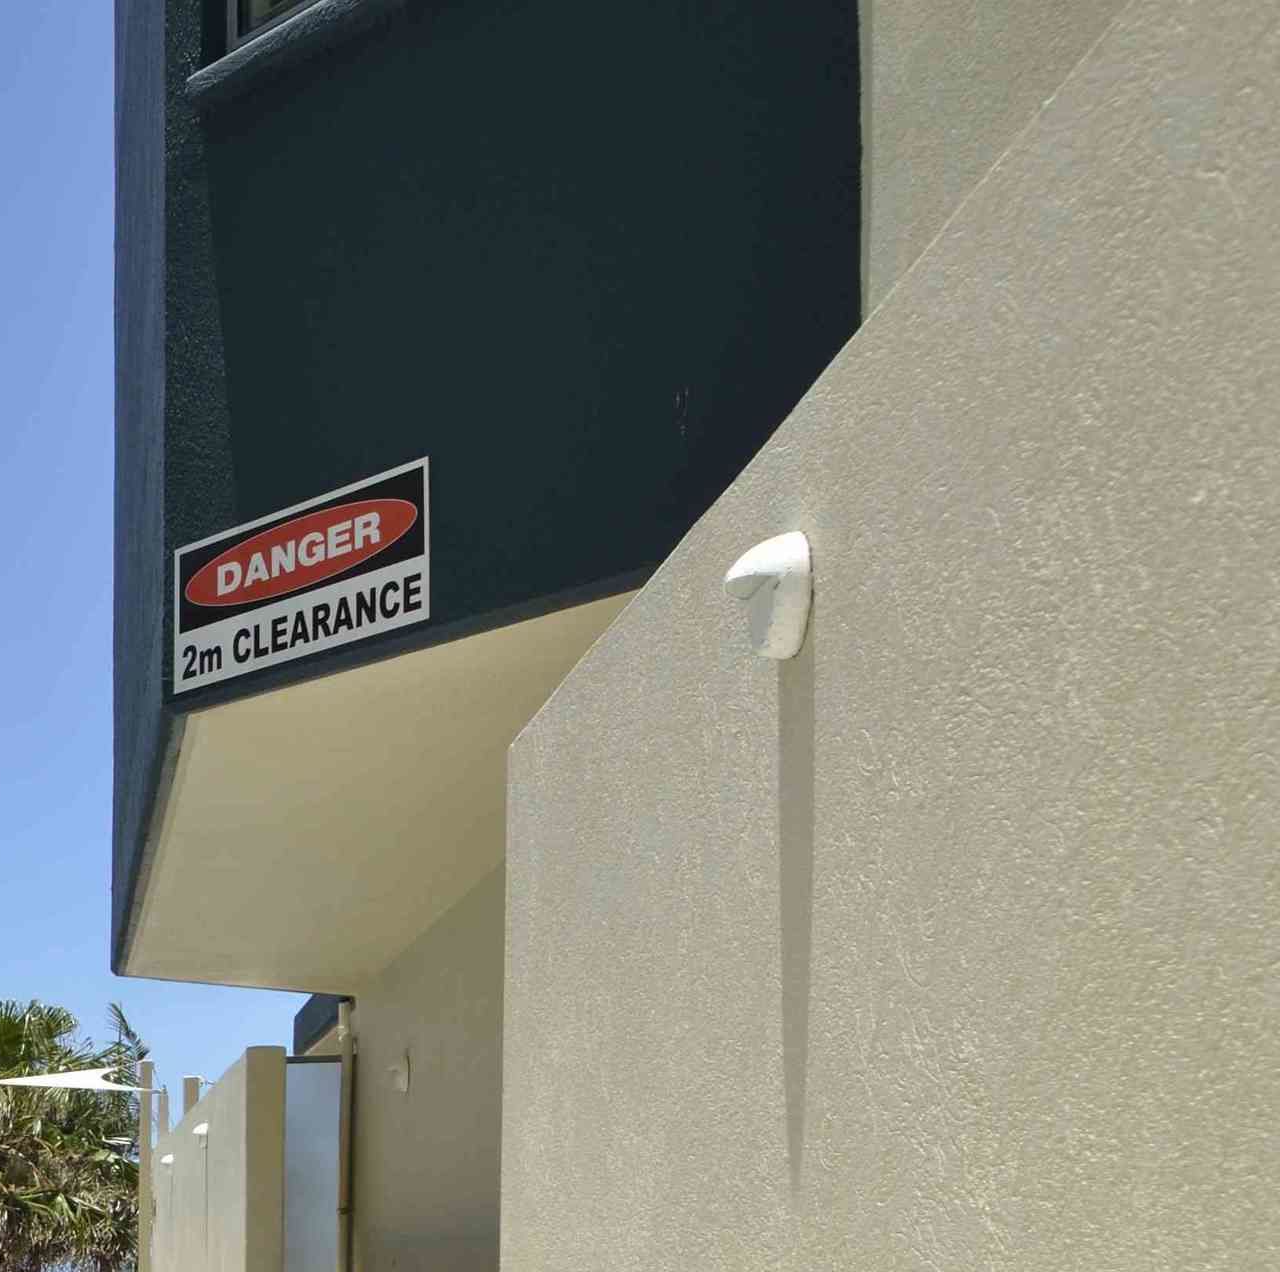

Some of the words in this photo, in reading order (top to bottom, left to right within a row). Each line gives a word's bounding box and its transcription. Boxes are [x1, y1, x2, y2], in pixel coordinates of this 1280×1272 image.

[216, 511, 382, 597] DANGER
[182, 644, 223, 681] 2m
[232, 572, 423, 664] CLEARANCE
